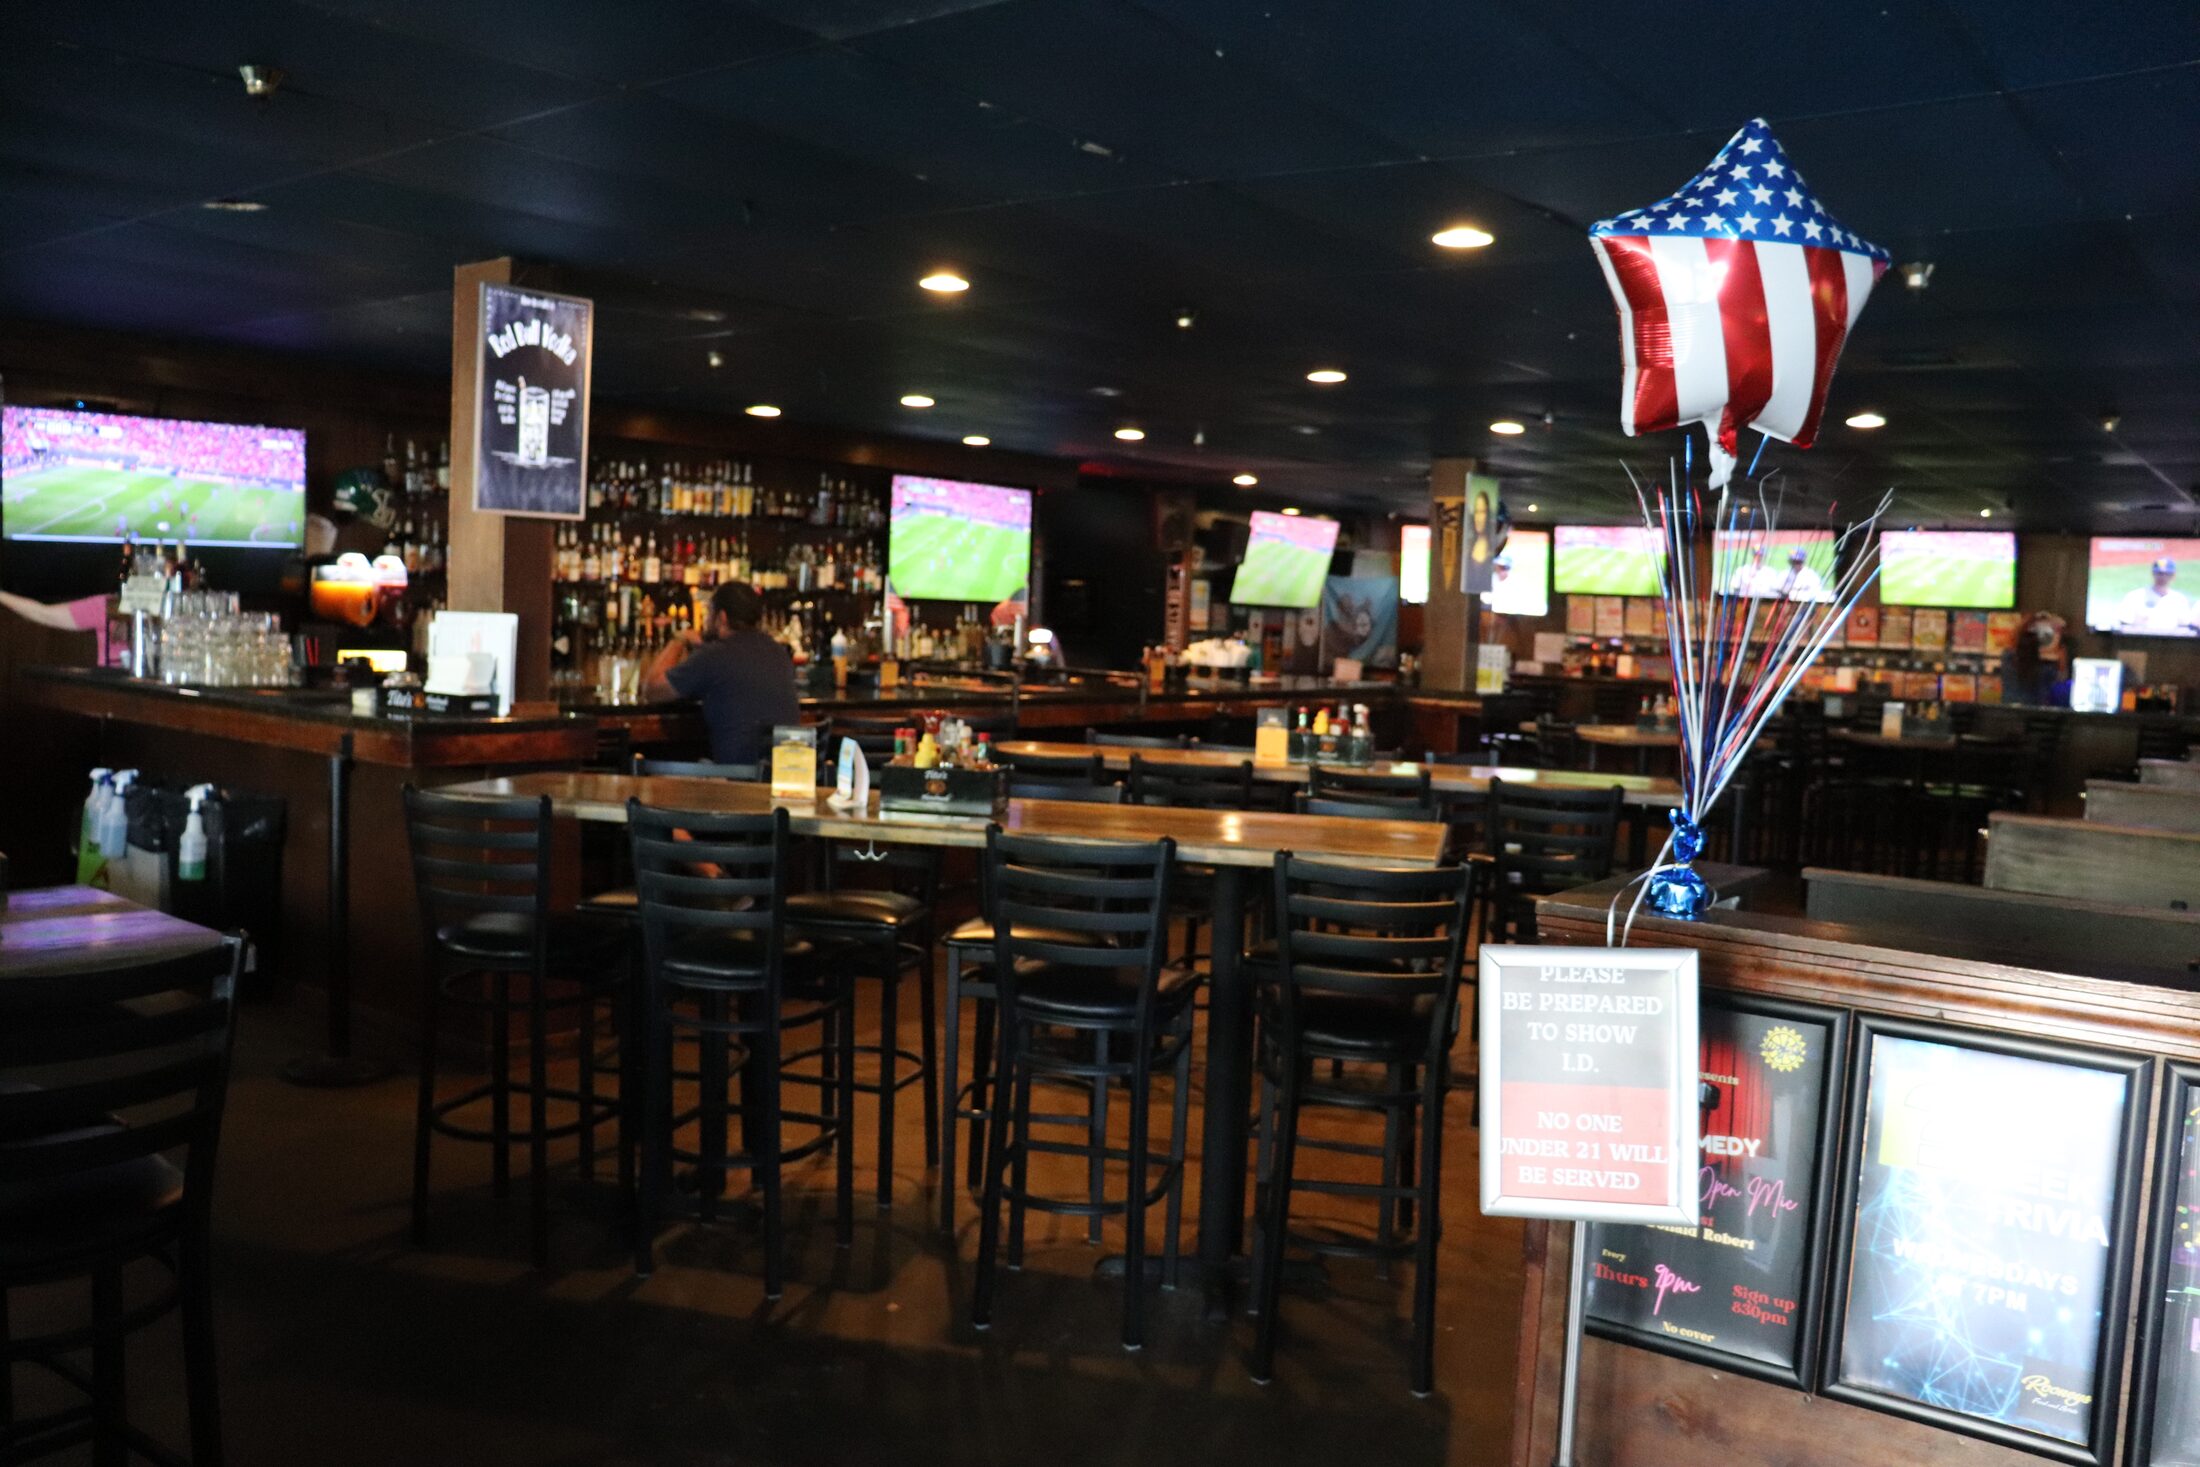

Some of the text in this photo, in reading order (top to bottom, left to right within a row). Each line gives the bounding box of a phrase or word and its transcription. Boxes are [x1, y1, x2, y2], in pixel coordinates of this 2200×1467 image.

[1540, 966, 1626, 984] PLEASE
[1503, 992, 1663, 1015] BE PREPARED
[1527, 1022, 1637, 1044] TO SHOW
[1562, 1053, 1600, 1072] I.D.
[1537, 1111, 1623, 1133] NO ONE
[1576, 1141, 1601, 1160] 21
[1608, 1143, 1668, 1165] WILL
[1698, 1134, 1761, 1157] MEDY
[1518, 1166, 1640, 1190] BE SERVED
[1698, 1166, 1798, 1218] Open Mic
[1595, 1263, 1648, 1288] Thurs
[1732, 1284, 1796, 1313] Sign up
[1973, 1281, 2027, 1312] 7PM
[1731, 1301, 1788, 1325] 830pm
[1662, 1320, 1715, 1343] No cover
